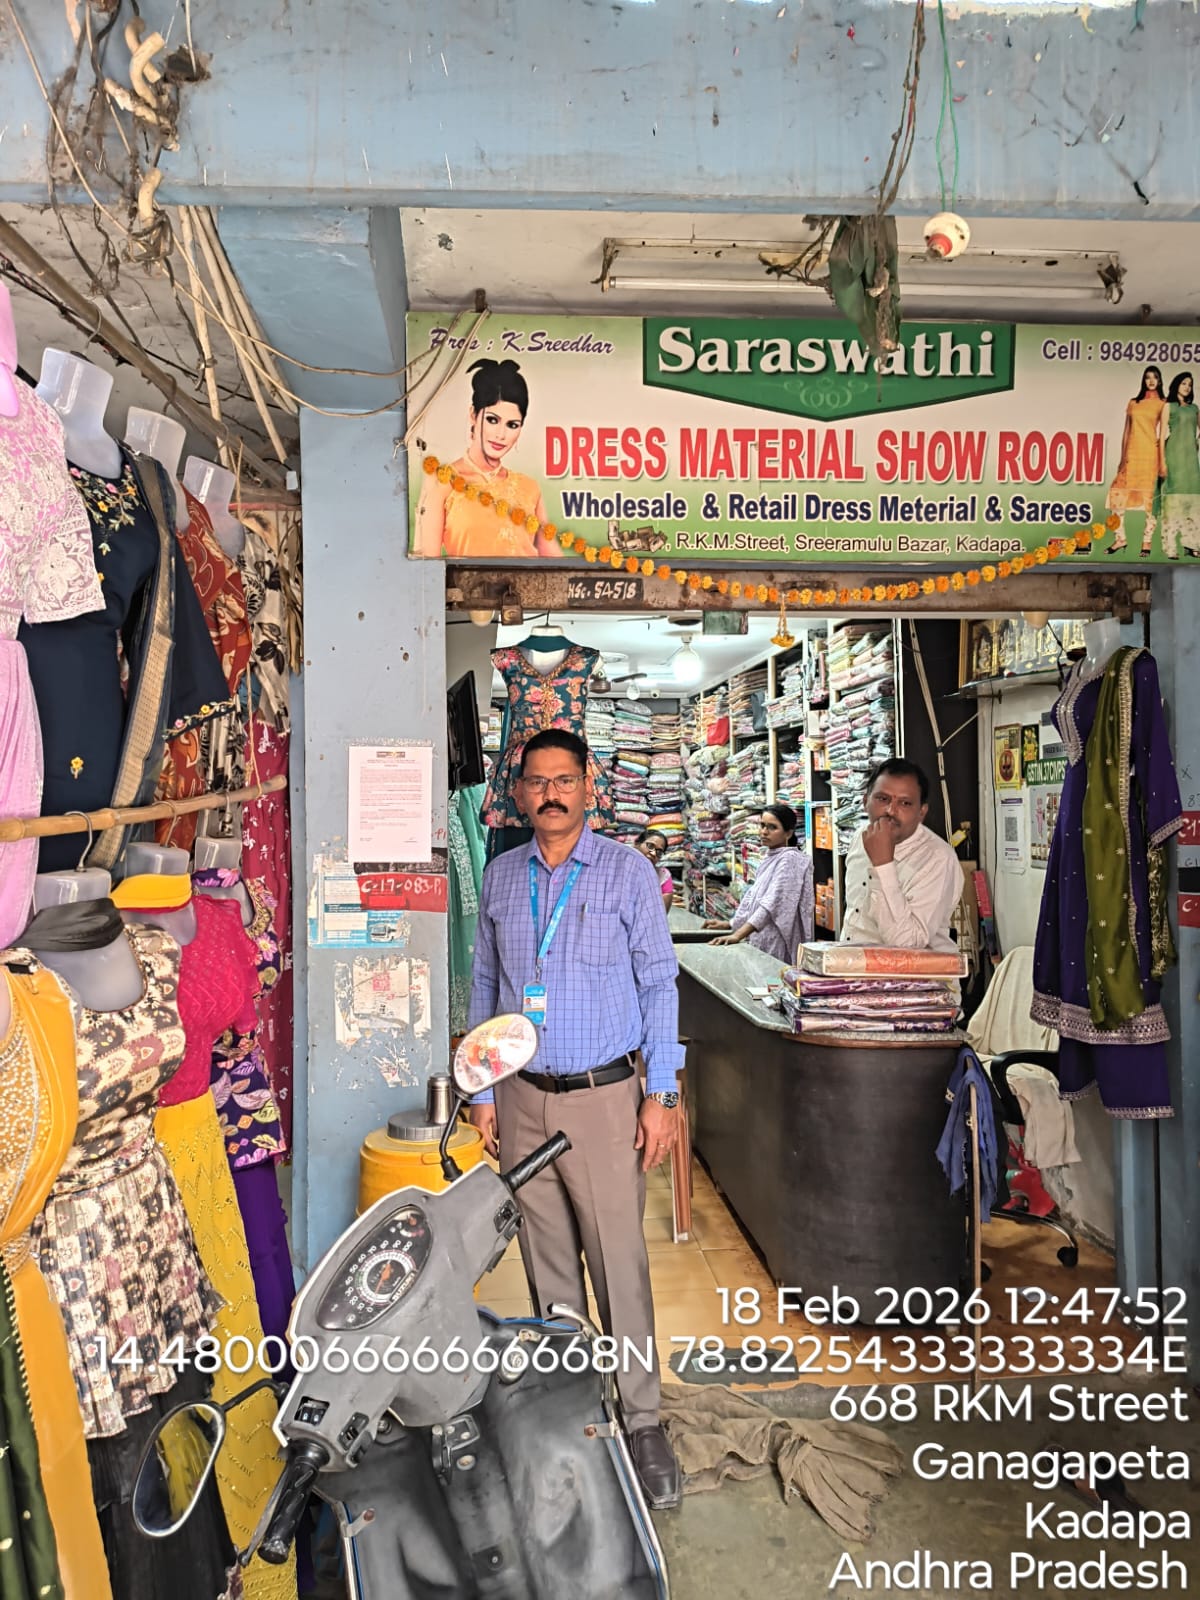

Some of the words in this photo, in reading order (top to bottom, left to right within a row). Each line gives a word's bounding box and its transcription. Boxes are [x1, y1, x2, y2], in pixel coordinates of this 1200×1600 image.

[501, 331, 614, 354] K.Sreedhar
[658, 326, 995, 378] Saraswathi
[1042, 340, 1081, 361] Cell
[1100, 341, 1200, 363] 984928055
[545, 426, 667, 478] DRESS
[679, 427, 865, 480] MATERIAL
[876, 429, 987, 482] SHOW
[998, 430, 1104, 483] ROOM
[561, 492, 687, 519] Wholesale
[702, 493, 720, 519] &
[728, 493, 797, 520] Retail
[805, 494, 872, 522] Dress
[879, 495, 976, 523] Meterial
[984, 497, 1002, 523] &
[1009, 497, 1092, 524] Sarees
[795, 534, 892, 552] Sreeramulu
[897, 535, 950, 555] Bazar,
[955, 536, 1026, 554] Kadapa.
